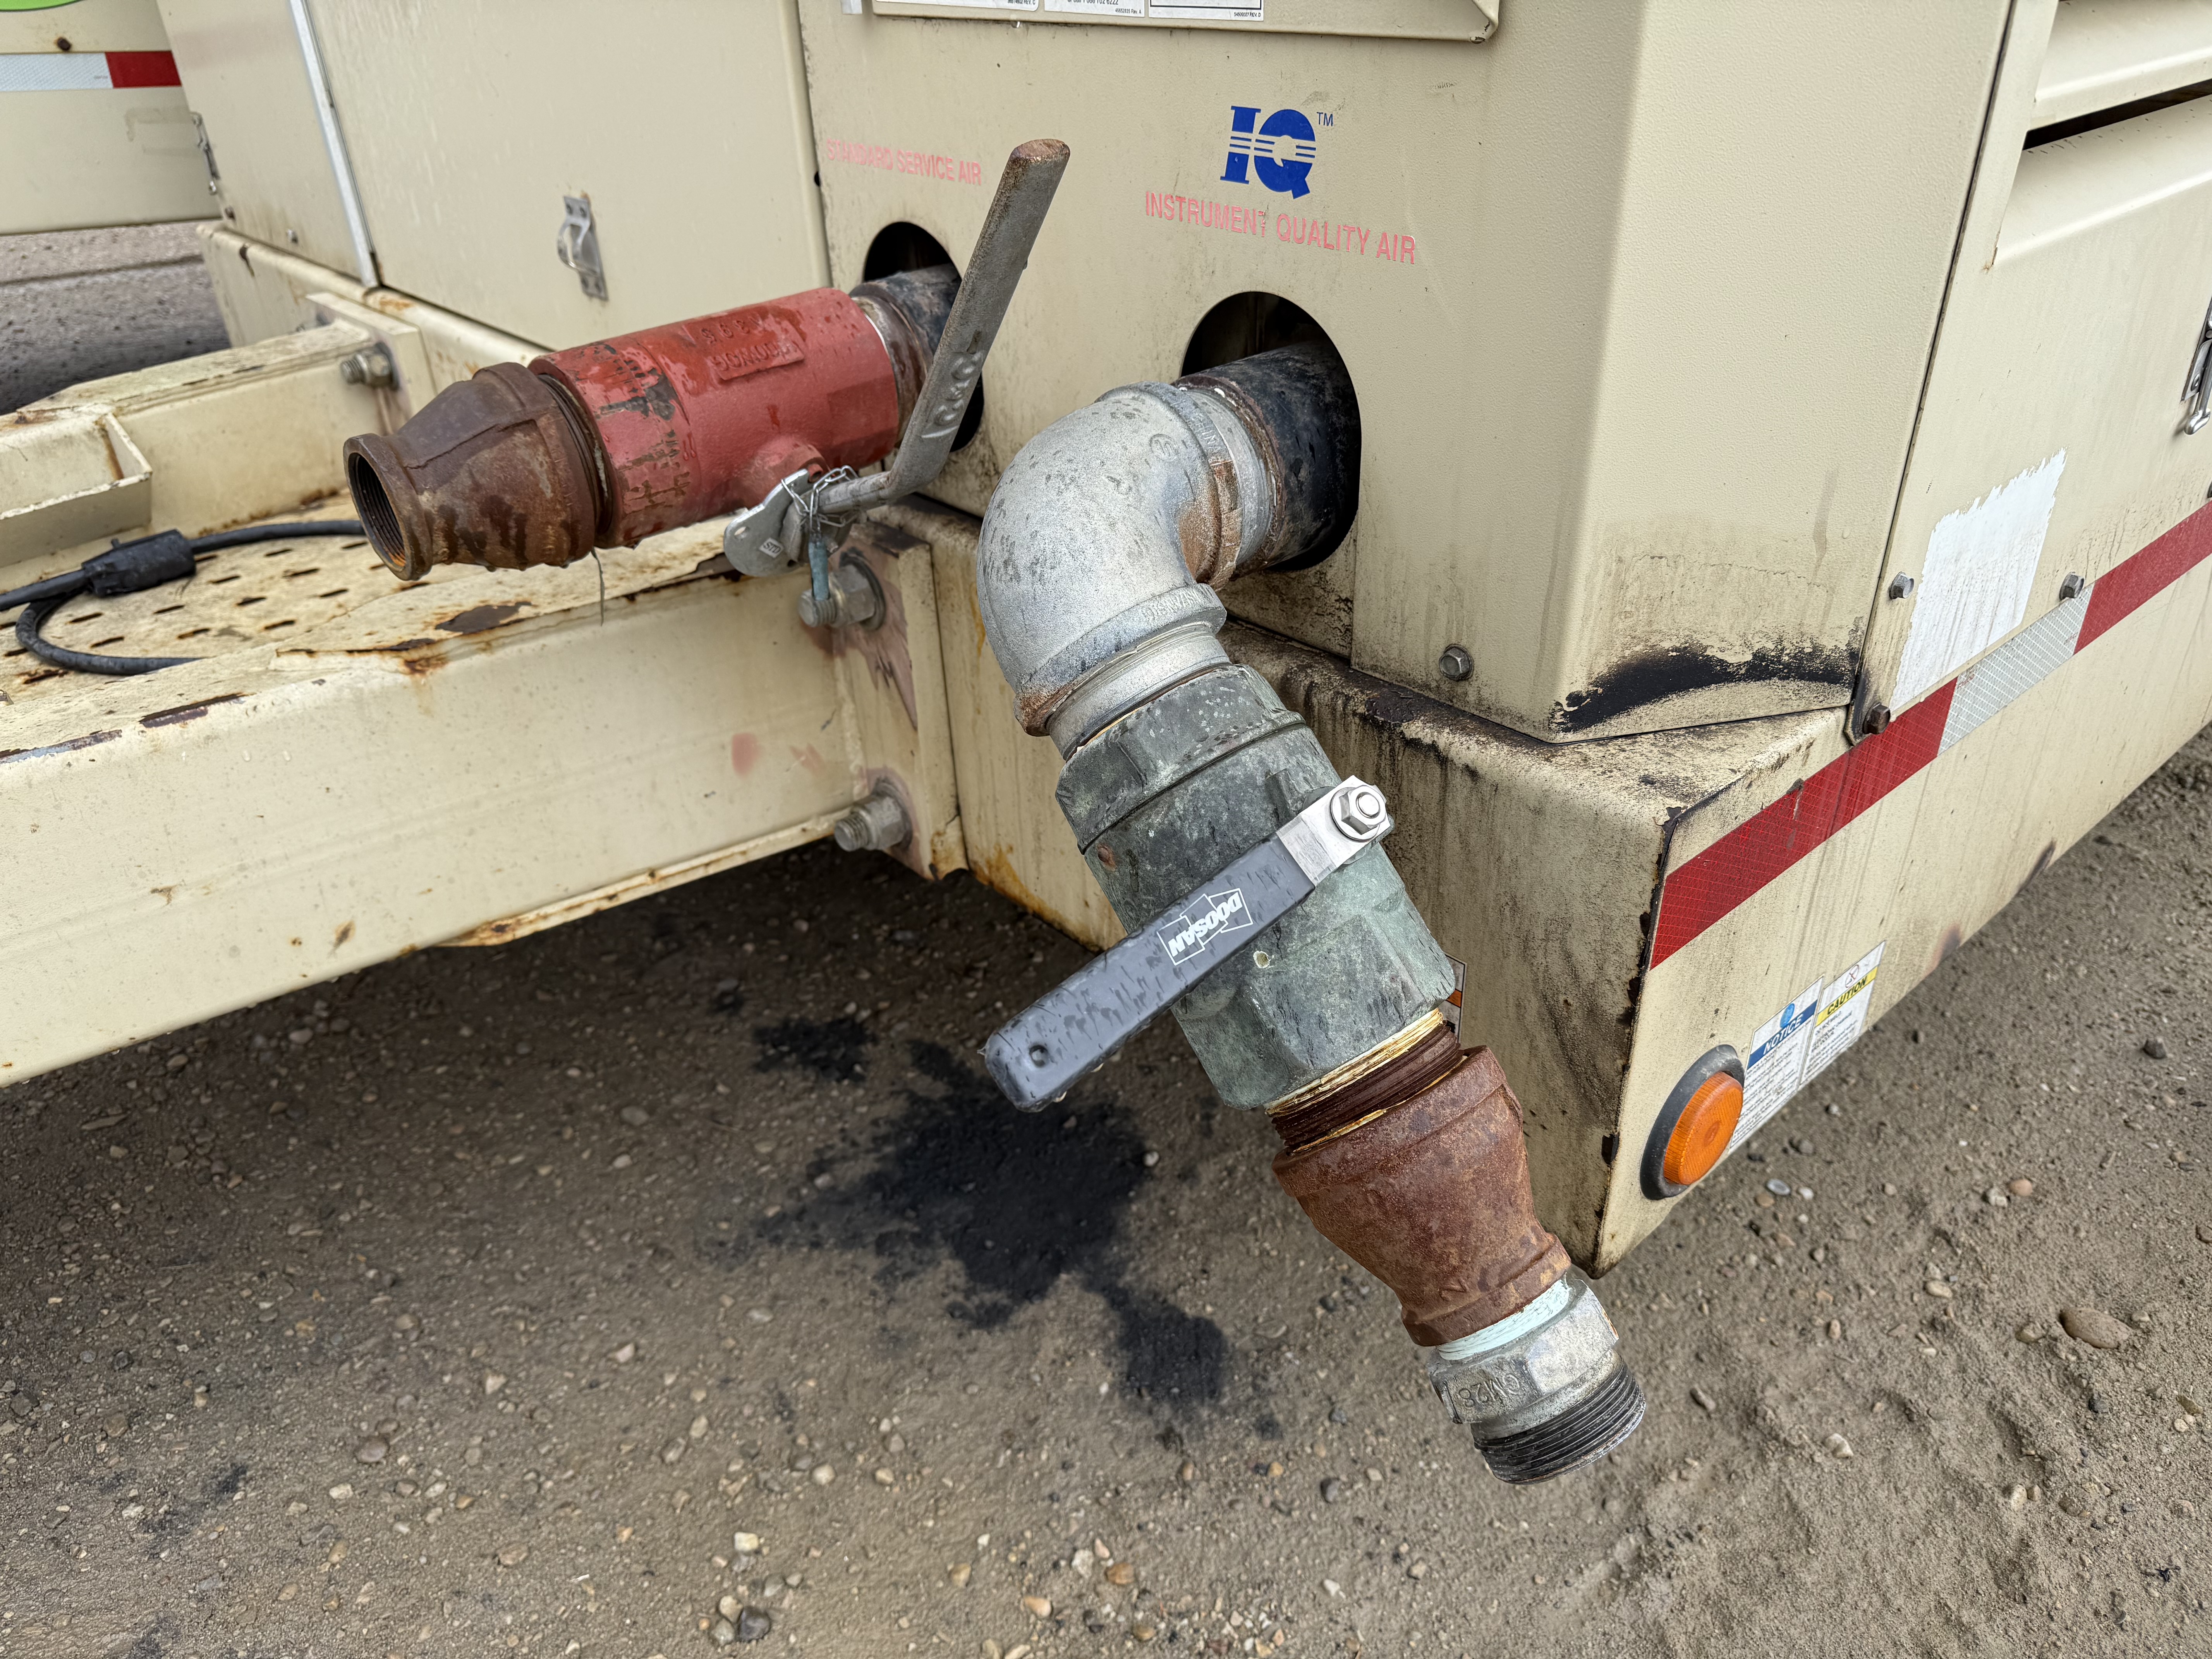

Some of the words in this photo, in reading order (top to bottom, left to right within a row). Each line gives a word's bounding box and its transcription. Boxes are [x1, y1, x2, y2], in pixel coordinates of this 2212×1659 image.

[826, 137, 894, 170] STANDARD
[896, 149, 955, 181] SERVICE
[958, 160, 982, 186] AIR
[1220, 105, 1316, 199] IQ
[1145, 191, 1266, 238] INSTRUMENT
[1276, 213, 1371, 255] QUALITY
[1376, 231, 1416, 264] AIR
[763, 541, 781, 554] STD
[1168, 891, 1243, 957] DOOSAN
[1827, 975, 1868, 1015] CAUTION
[1763, 1013, 1803, 1055] NOTICE
